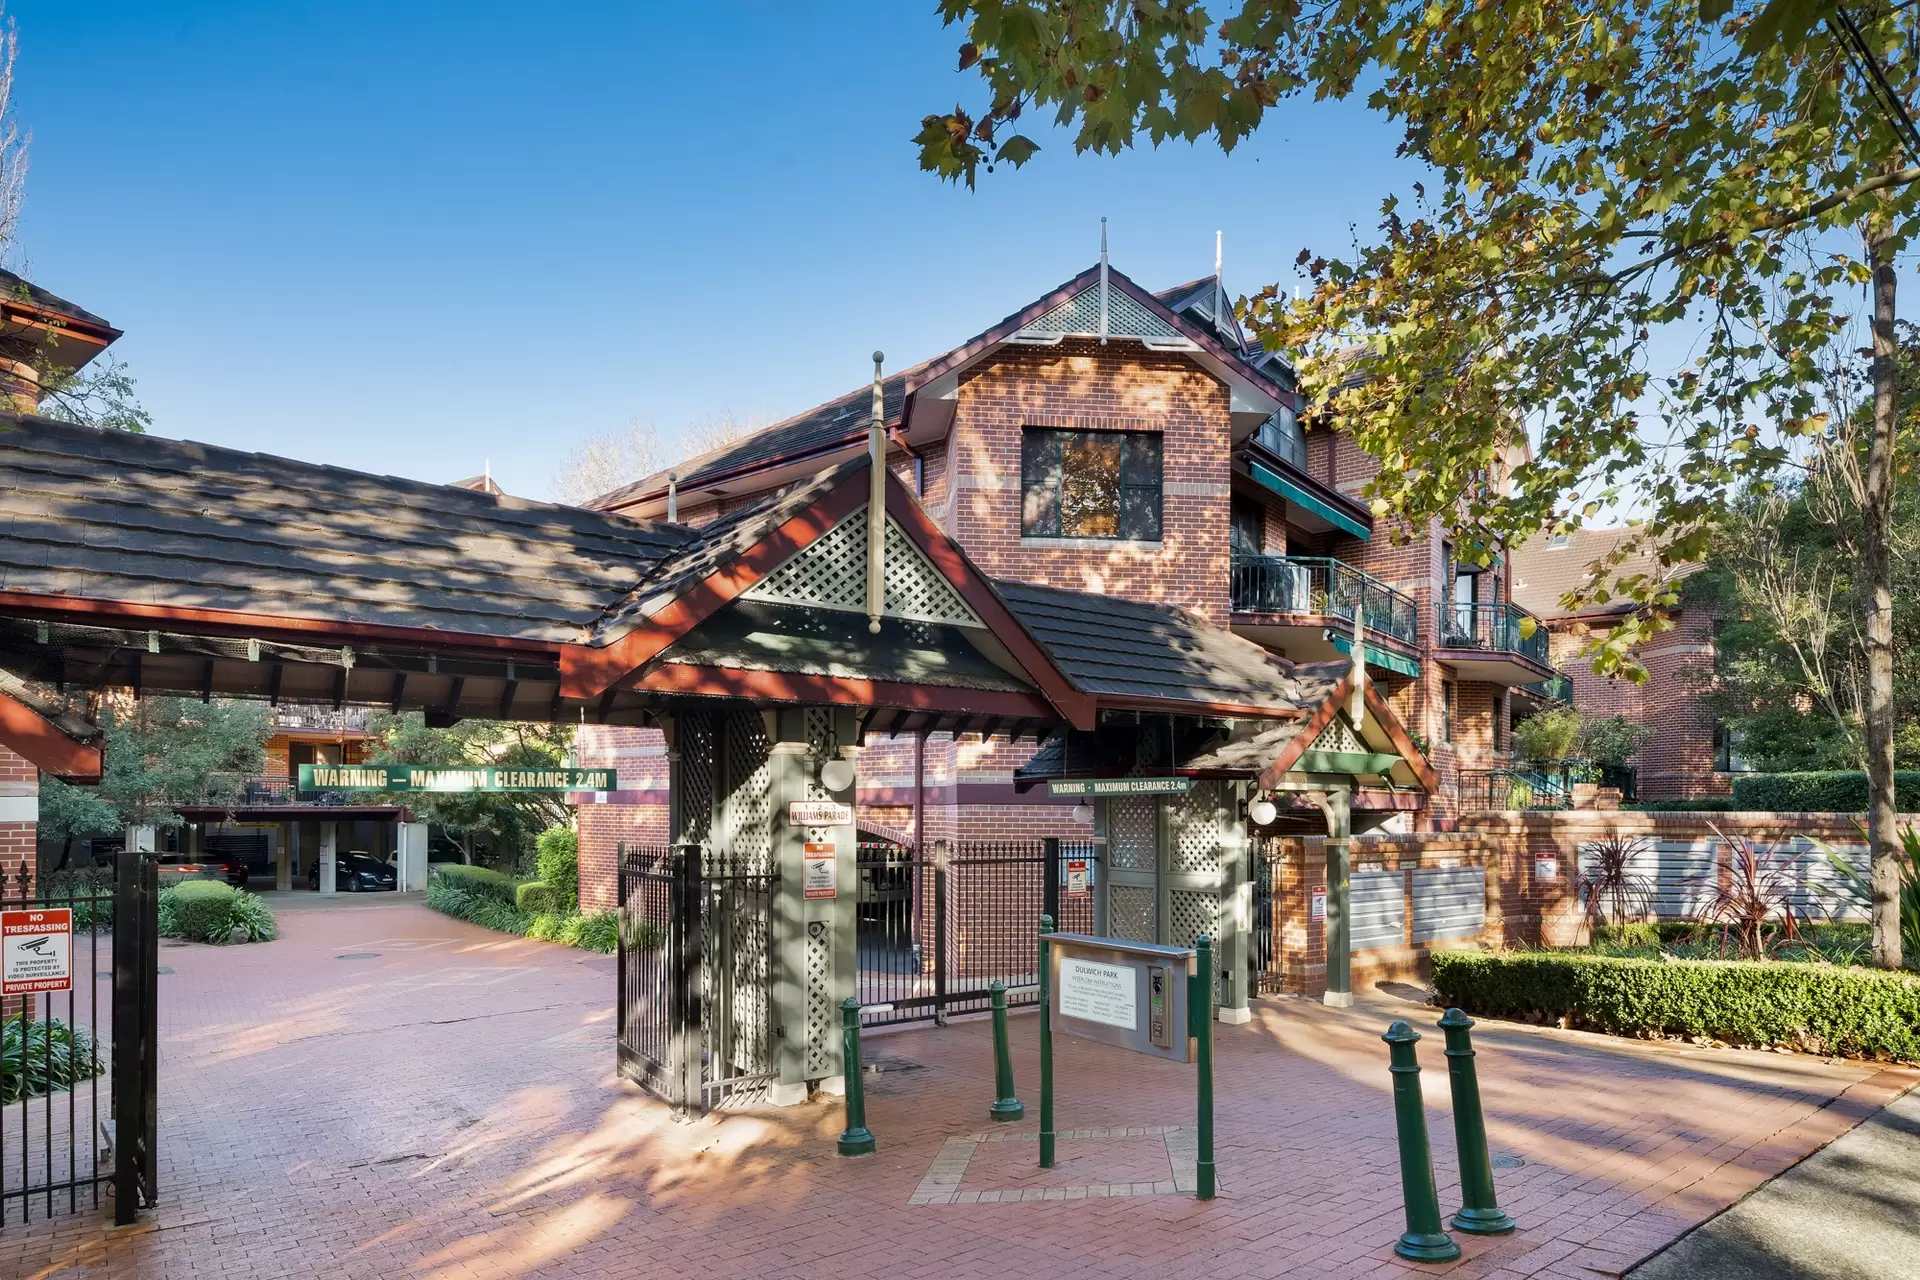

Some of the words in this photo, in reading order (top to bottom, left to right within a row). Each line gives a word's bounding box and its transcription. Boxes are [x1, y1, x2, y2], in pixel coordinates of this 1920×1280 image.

[313, 768, 388, 787] WARNING
[494, 771, 569, 788] CLEARANCE
[576, 772, 608, 788] 2.4M
[1052, 783, 1085, 794] WARNING
[1094, 782, 1130, 793] MAXIMUM
[1130, 781, 1170, 791] CLEARANCE
[1170, 780, 1187, 790] 2.4m
[791, 811, 823, 821] WILLIAMS
[824, 811, 849, 820] PARADE
[29, 914, 44, 922] NO
[4, 923, 68, 934] TRESPASSING
[26, 970, 66, 978] SURVEILLANCE
[1075, 966, 1102, 976] DULWICH
[1103, 970, 1119, 979] PARK
[5, 982, 33, 992] PRIVATE
[34, 980, 68, 989] PROPERTY
